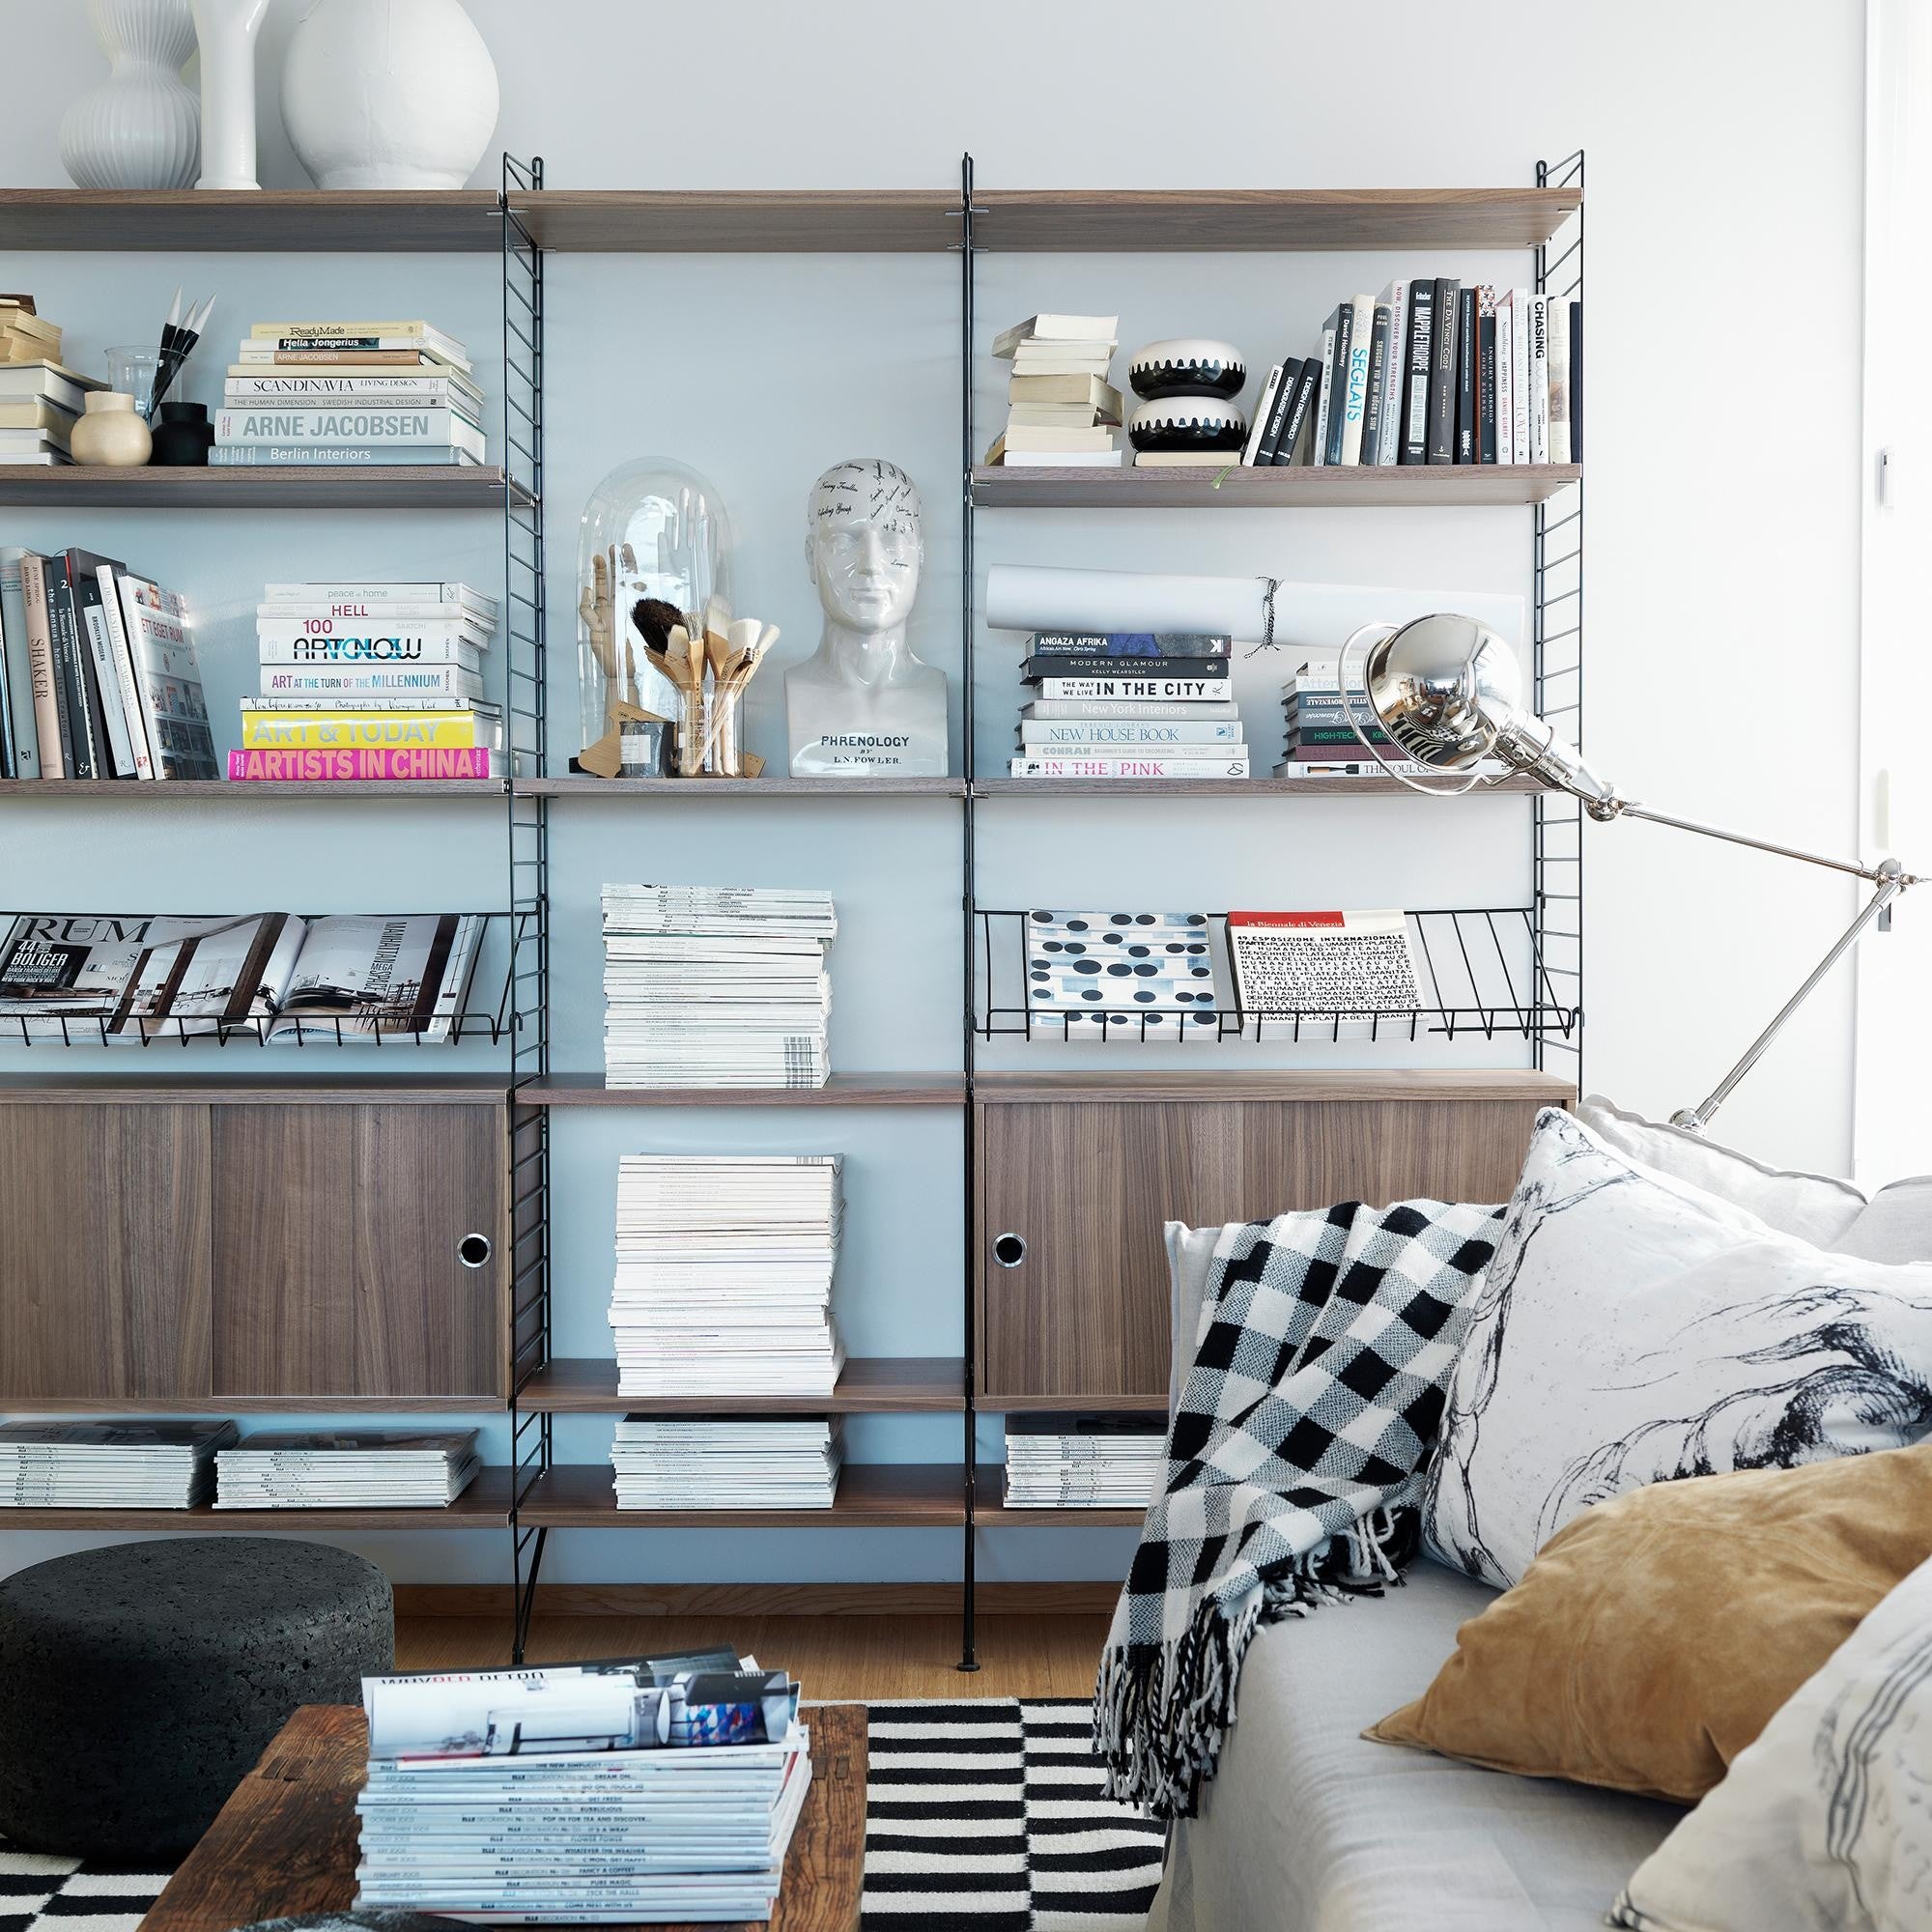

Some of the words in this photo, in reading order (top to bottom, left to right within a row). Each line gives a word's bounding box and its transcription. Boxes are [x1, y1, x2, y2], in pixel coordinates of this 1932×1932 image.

[290, 327, 345, 337] ReadyMade
[1534, 301, 1545, 358] CHASING
[283, 338, 308, 347] Hella
[312, 338, 359, 348] Jongerius
[1412, 307, 1431, 370] MAPPLETHORPE
[1339, 339, 1348, 367] Hockney
[253, 380, 355, 392] SCANDINAVIA
[1347, 348, 1367, 421] SEGLATS
[1300, 382, 1312, 403] DESIGN
[242, 415, 304, 437] ARNE
[310, 415, 429, 437] JACOBSEN
[1269, 415, 1281, 437] DESIGN
[270, 448, 309, 460] Berlin
[314, 448, 371, 460] Interiors
[61, 580, 68, 588] 2
[327, 588, 355, 598] peace
[363, 588, 387, 598] home
[332, 605, 368, 616] HELL
[49, 609, 59, 642] sensual
[92, 616, 101, 640] BROOKLYN
[302, 619, 332, 634] 100
[1039, 638, 1074, 646] ANGAZA
[1076, 638, 1108, 646] AFRIKA
[95, 640, 105, 662] MODERN
[31, 639, 48, 698] SHAKER
[271, 675, 293, 688] ART
[294, 679, 302, 688] AT
[304, 679, 319, 688] THE
[321, 679, 341, 688] TURN
[343, 679, 353, 688] OF
[355, 678, 370, 688] THE
[372, 675, 440, 688] MILLENNIUM
[1096, 683, 1114, 696] IN
[1122, 683, 1157, 696] THE
[1164, 683, 1206, 696] CITY
[1082, 703, 1109, 714] New
[1110, 703, 1135, 714] York
[1139, 703, 1187, 715] Interiors
[252, 719, 307, 743] ART
[319, 720, 340, 743] &
[348, 718, 440, 743] TODAY
[1050, 728, 1084, 741] NEW
[1090, 728, 1135, 741] HOUSE
[1141, 728, 1179, 741] BOOK
[821, 736, 910, 747] PHRENOLOGY
[1042, 747, 1091, 755] CONRAN
[246, 750, 354, 780] ARTISTS
[360, 750, 384, 780] IN
[391, 749, 474, 779] CHINA
[1045, 762, 1063, 775] IN
[1072, 762, 1108, 775] THE
[1121, 762, 1164, 775] PINK
[1392, 764, 1415, 774] OUL
[16, 918, 152, 943] RUM
[18, 941, 35, 953] 44
[376, 922, 407, 962] MANHATTAN
[11, 953, 68, 966] BOLIGER
[370, 962, 393, 972] MEGA
[363, 970, 391, 992] SPACE
